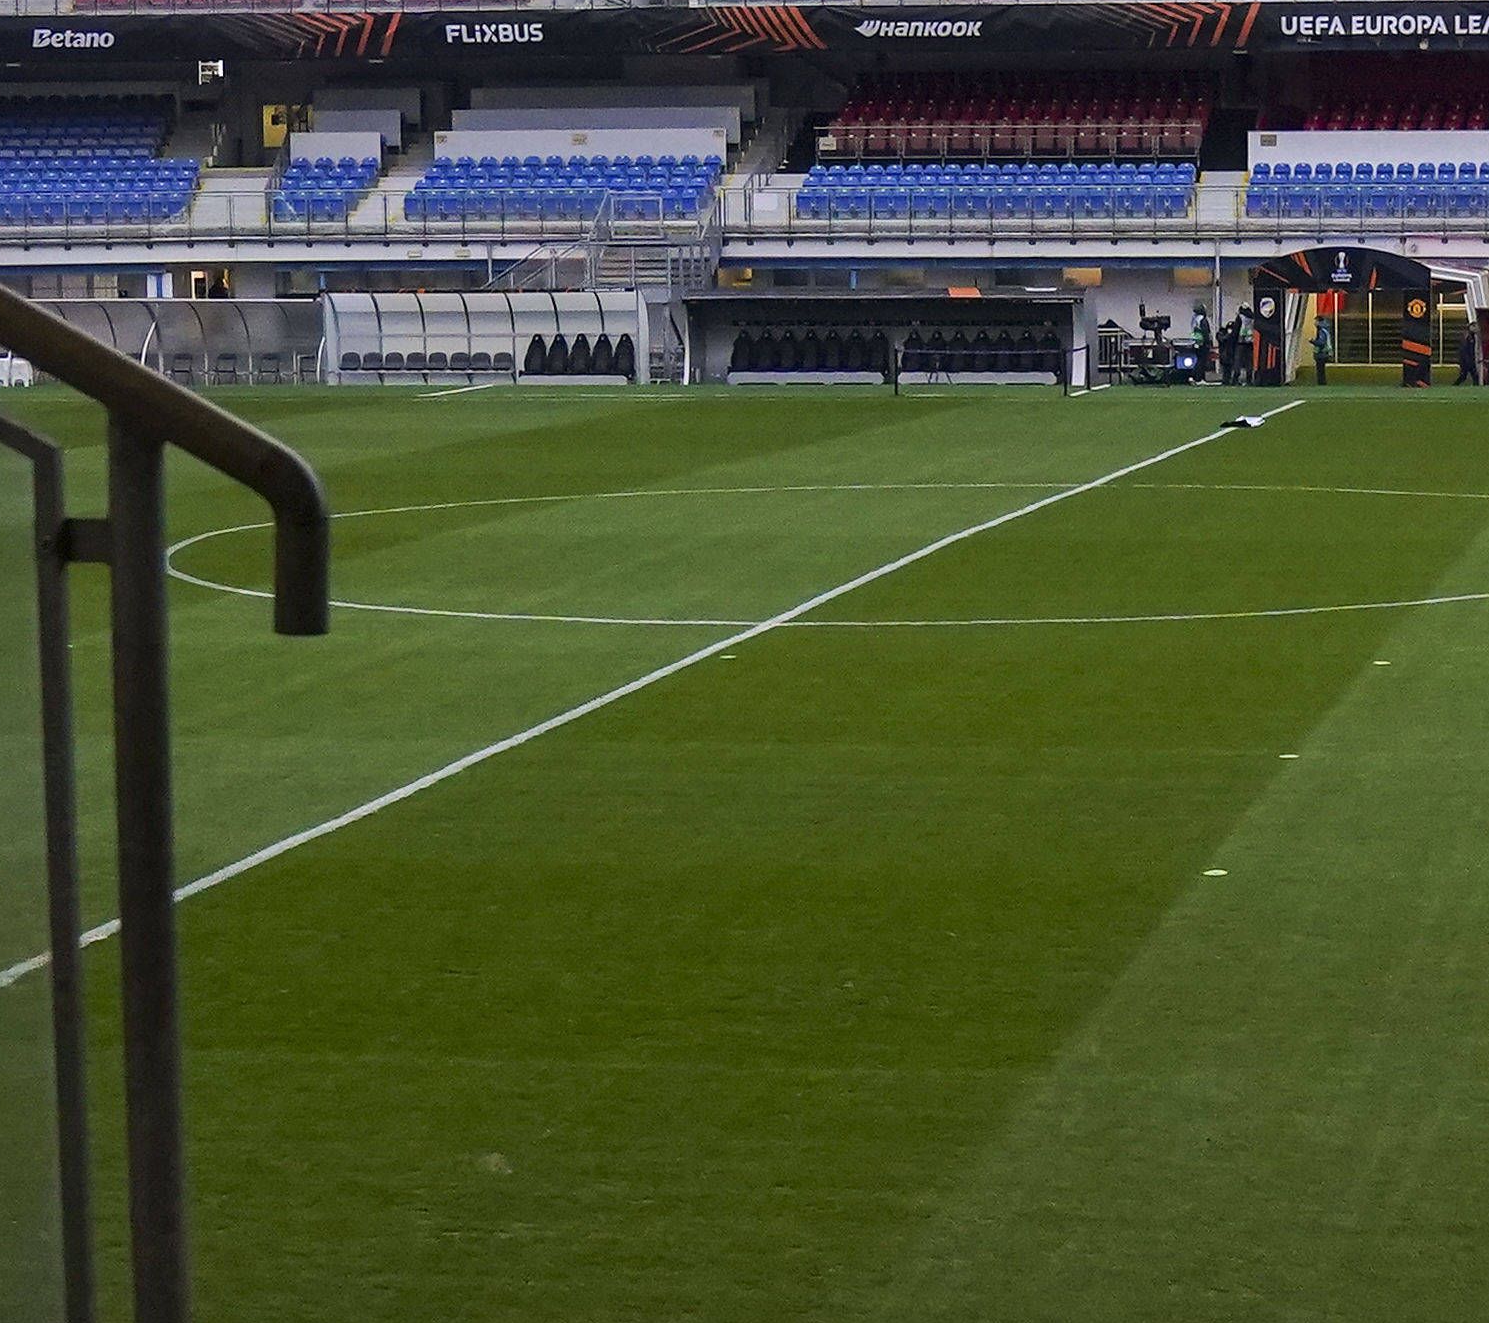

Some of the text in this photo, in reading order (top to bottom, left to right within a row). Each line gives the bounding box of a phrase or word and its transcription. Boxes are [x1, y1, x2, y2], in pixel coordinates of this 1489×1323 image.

[1280, 15, 1345, 36] UEFA
[1351, 14, 1450, 35] EUROPA
[32, 28, 115, 48] Betano
